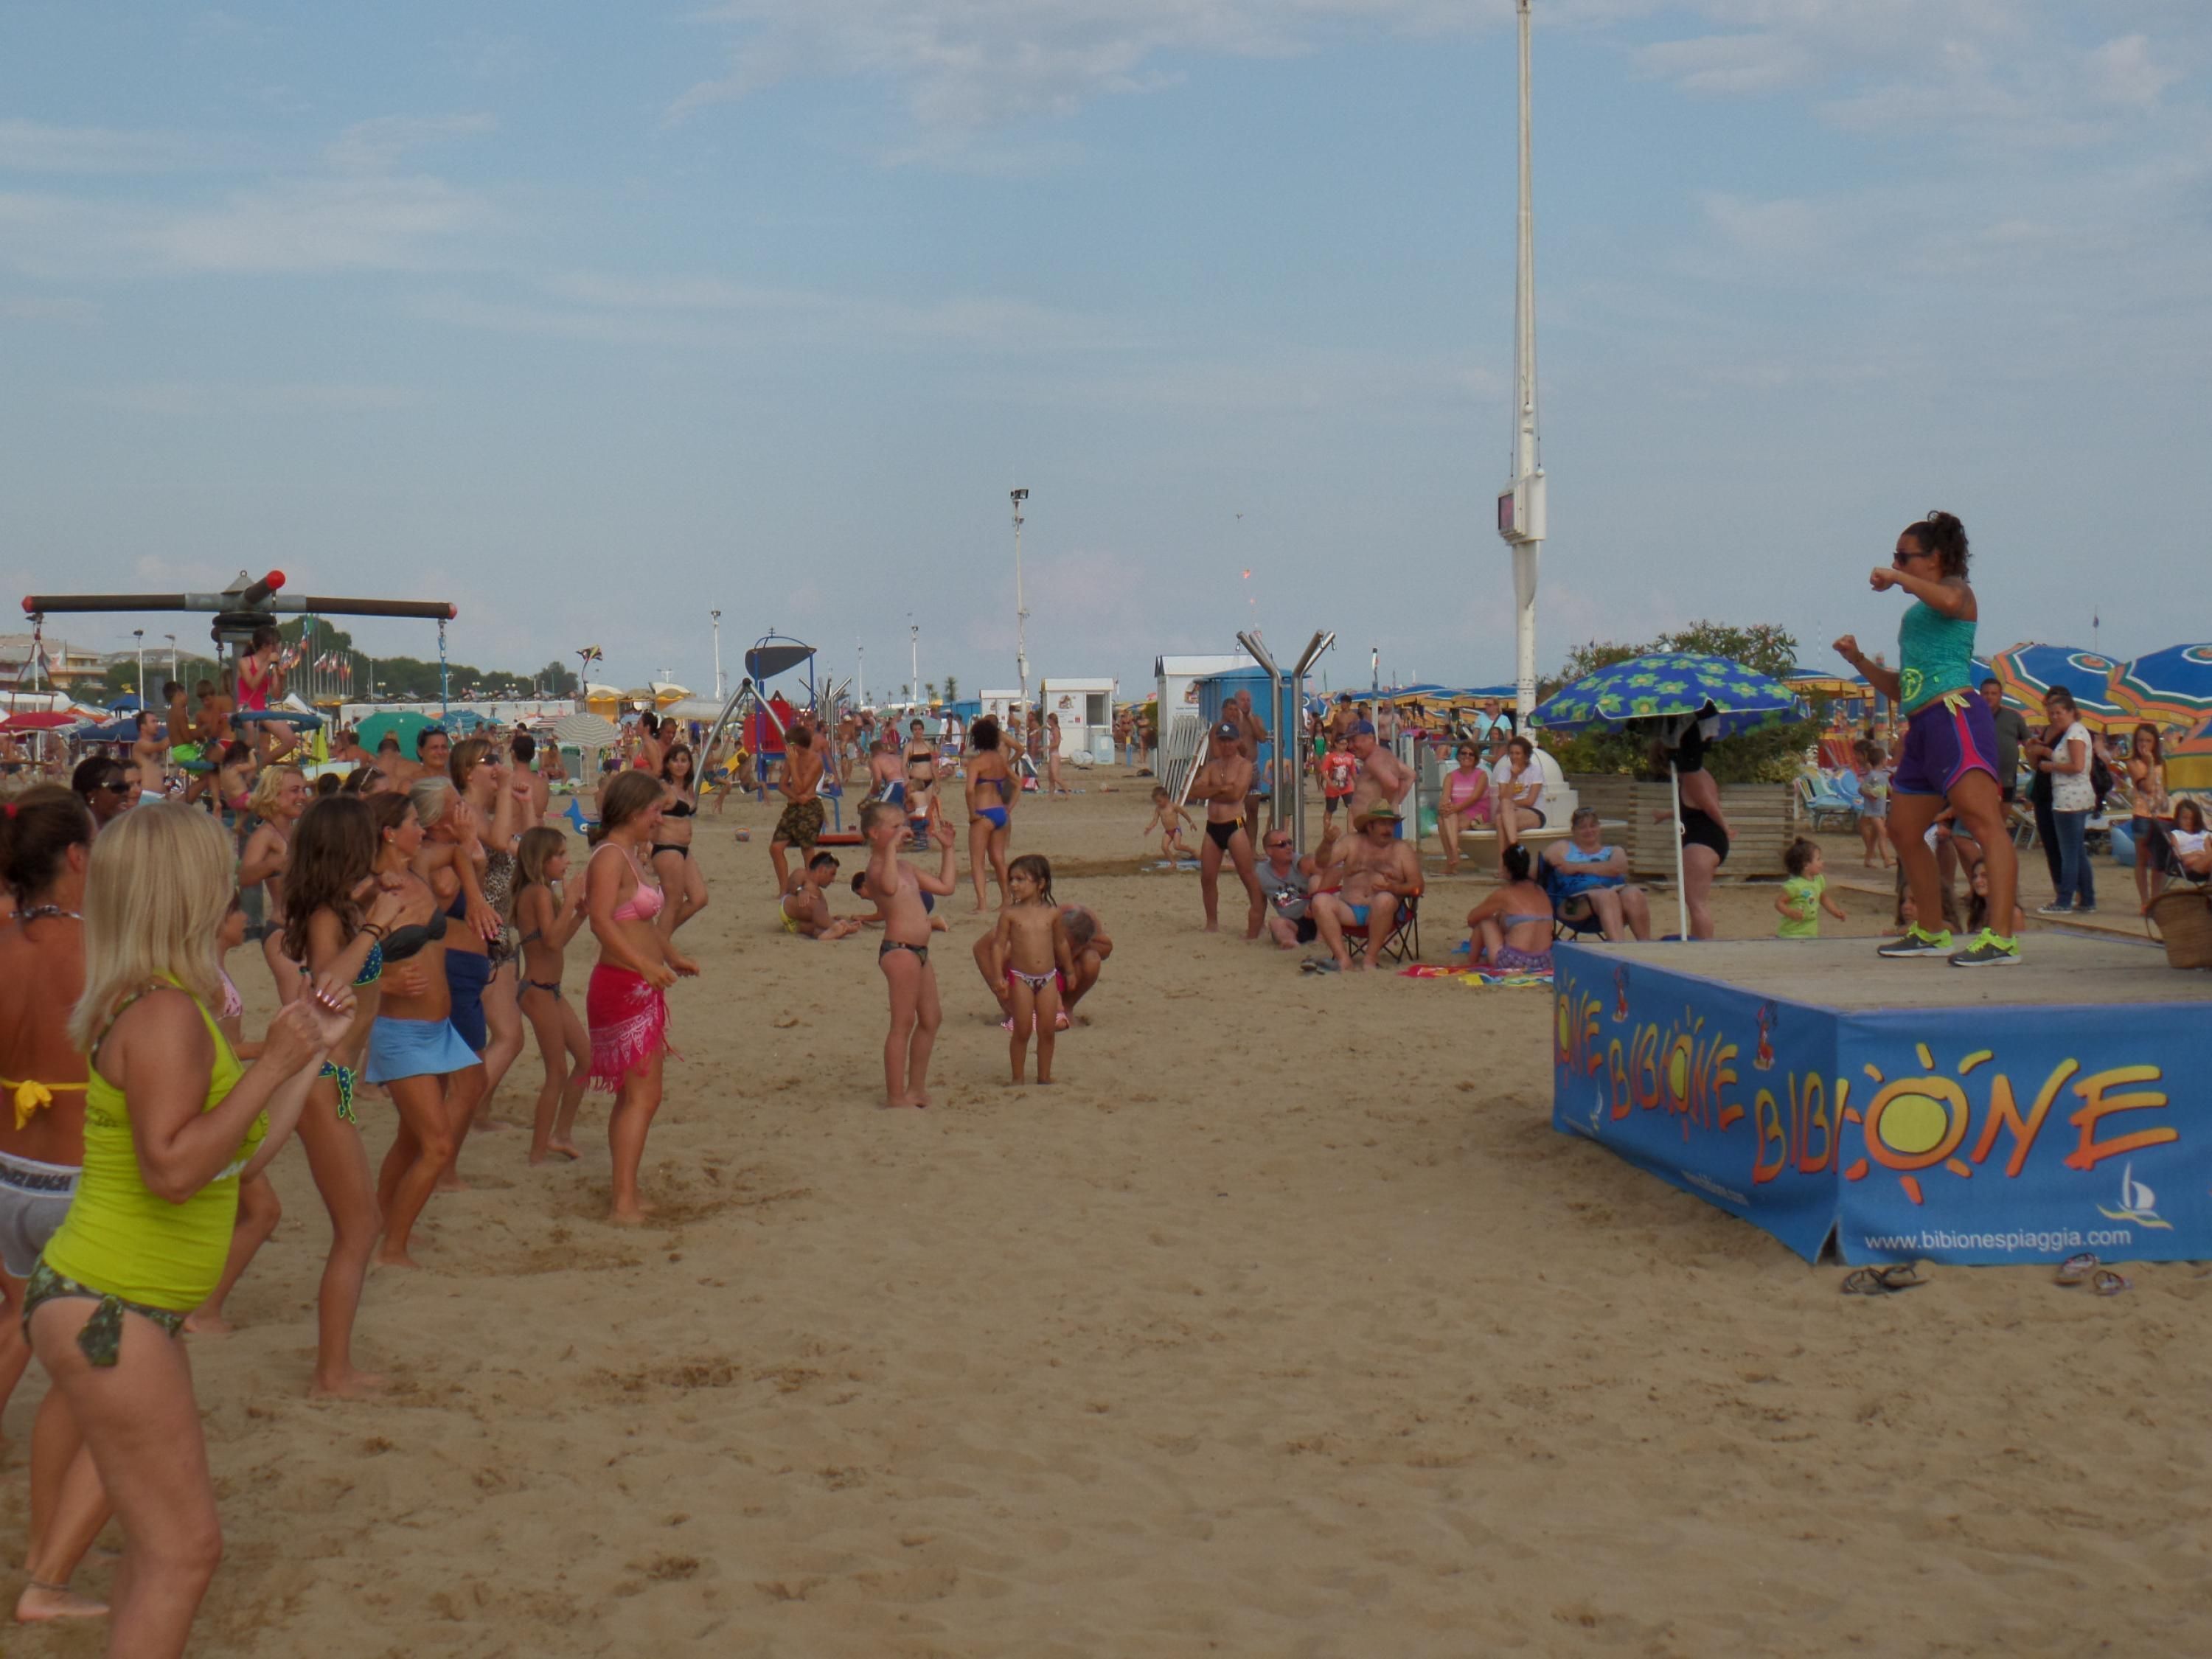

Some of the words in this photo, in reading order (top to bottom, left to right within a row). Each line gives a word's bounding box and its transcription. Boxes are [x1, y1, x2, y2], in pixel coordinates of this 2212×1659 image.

[1609, 1020, 1745, 1133] BIBIONE
[1752, 1056, 2180, 1186] BIBIONE
[1865, 1228, 2132, 1252] www.bibionespiaggia.com
